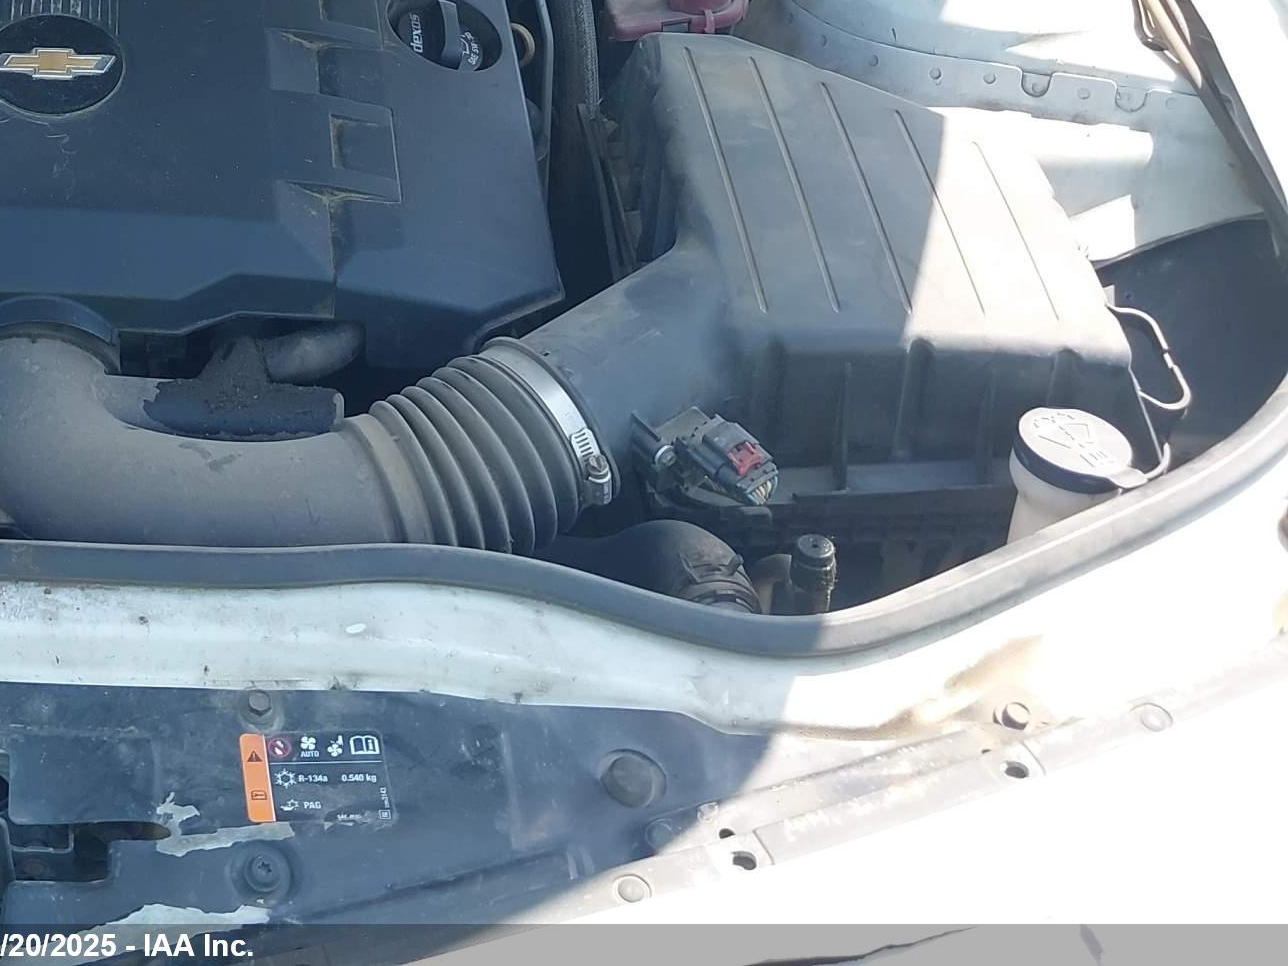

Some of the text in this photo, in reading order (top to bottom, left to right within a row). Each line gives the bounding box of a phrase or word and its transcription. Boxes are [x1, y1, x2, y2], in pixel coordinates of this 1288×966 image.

[410, 13, 423, 53] dexos
[298, 774, 377, 783] R-134a 0.540 kg
